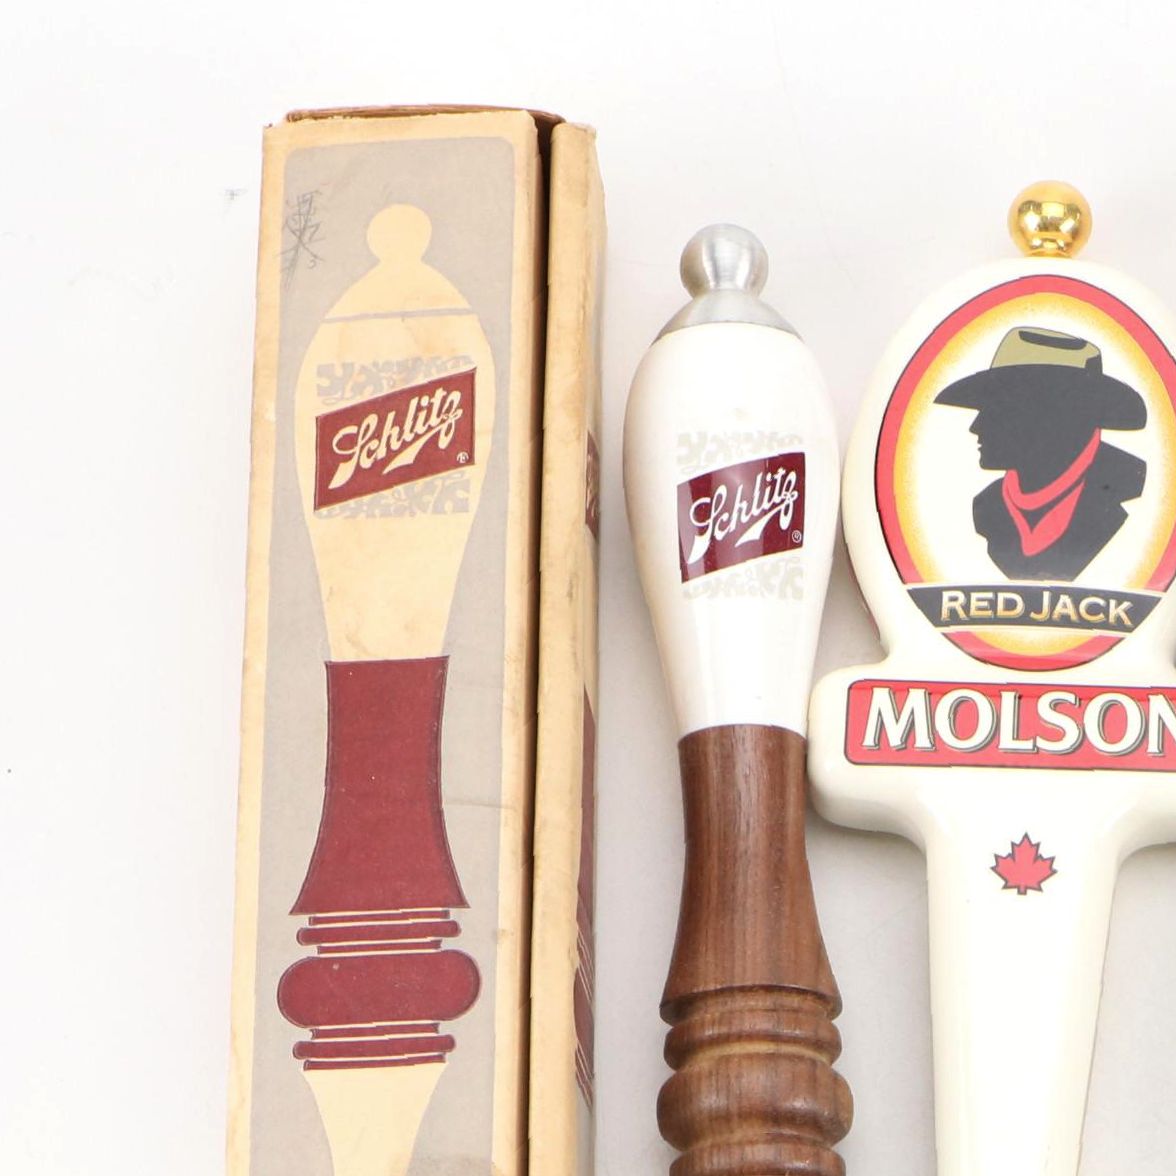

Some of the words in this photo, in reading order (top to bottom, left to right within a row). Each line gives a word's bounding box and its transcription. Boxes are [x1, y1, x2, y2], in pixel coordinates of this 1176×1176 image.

[328, 387, 463, 490] Schlitz
[687, 467, 798, 565] Schlitz
[940, 590, 1025, 622] RED
[1030, 592, 1135, 628] JACK
